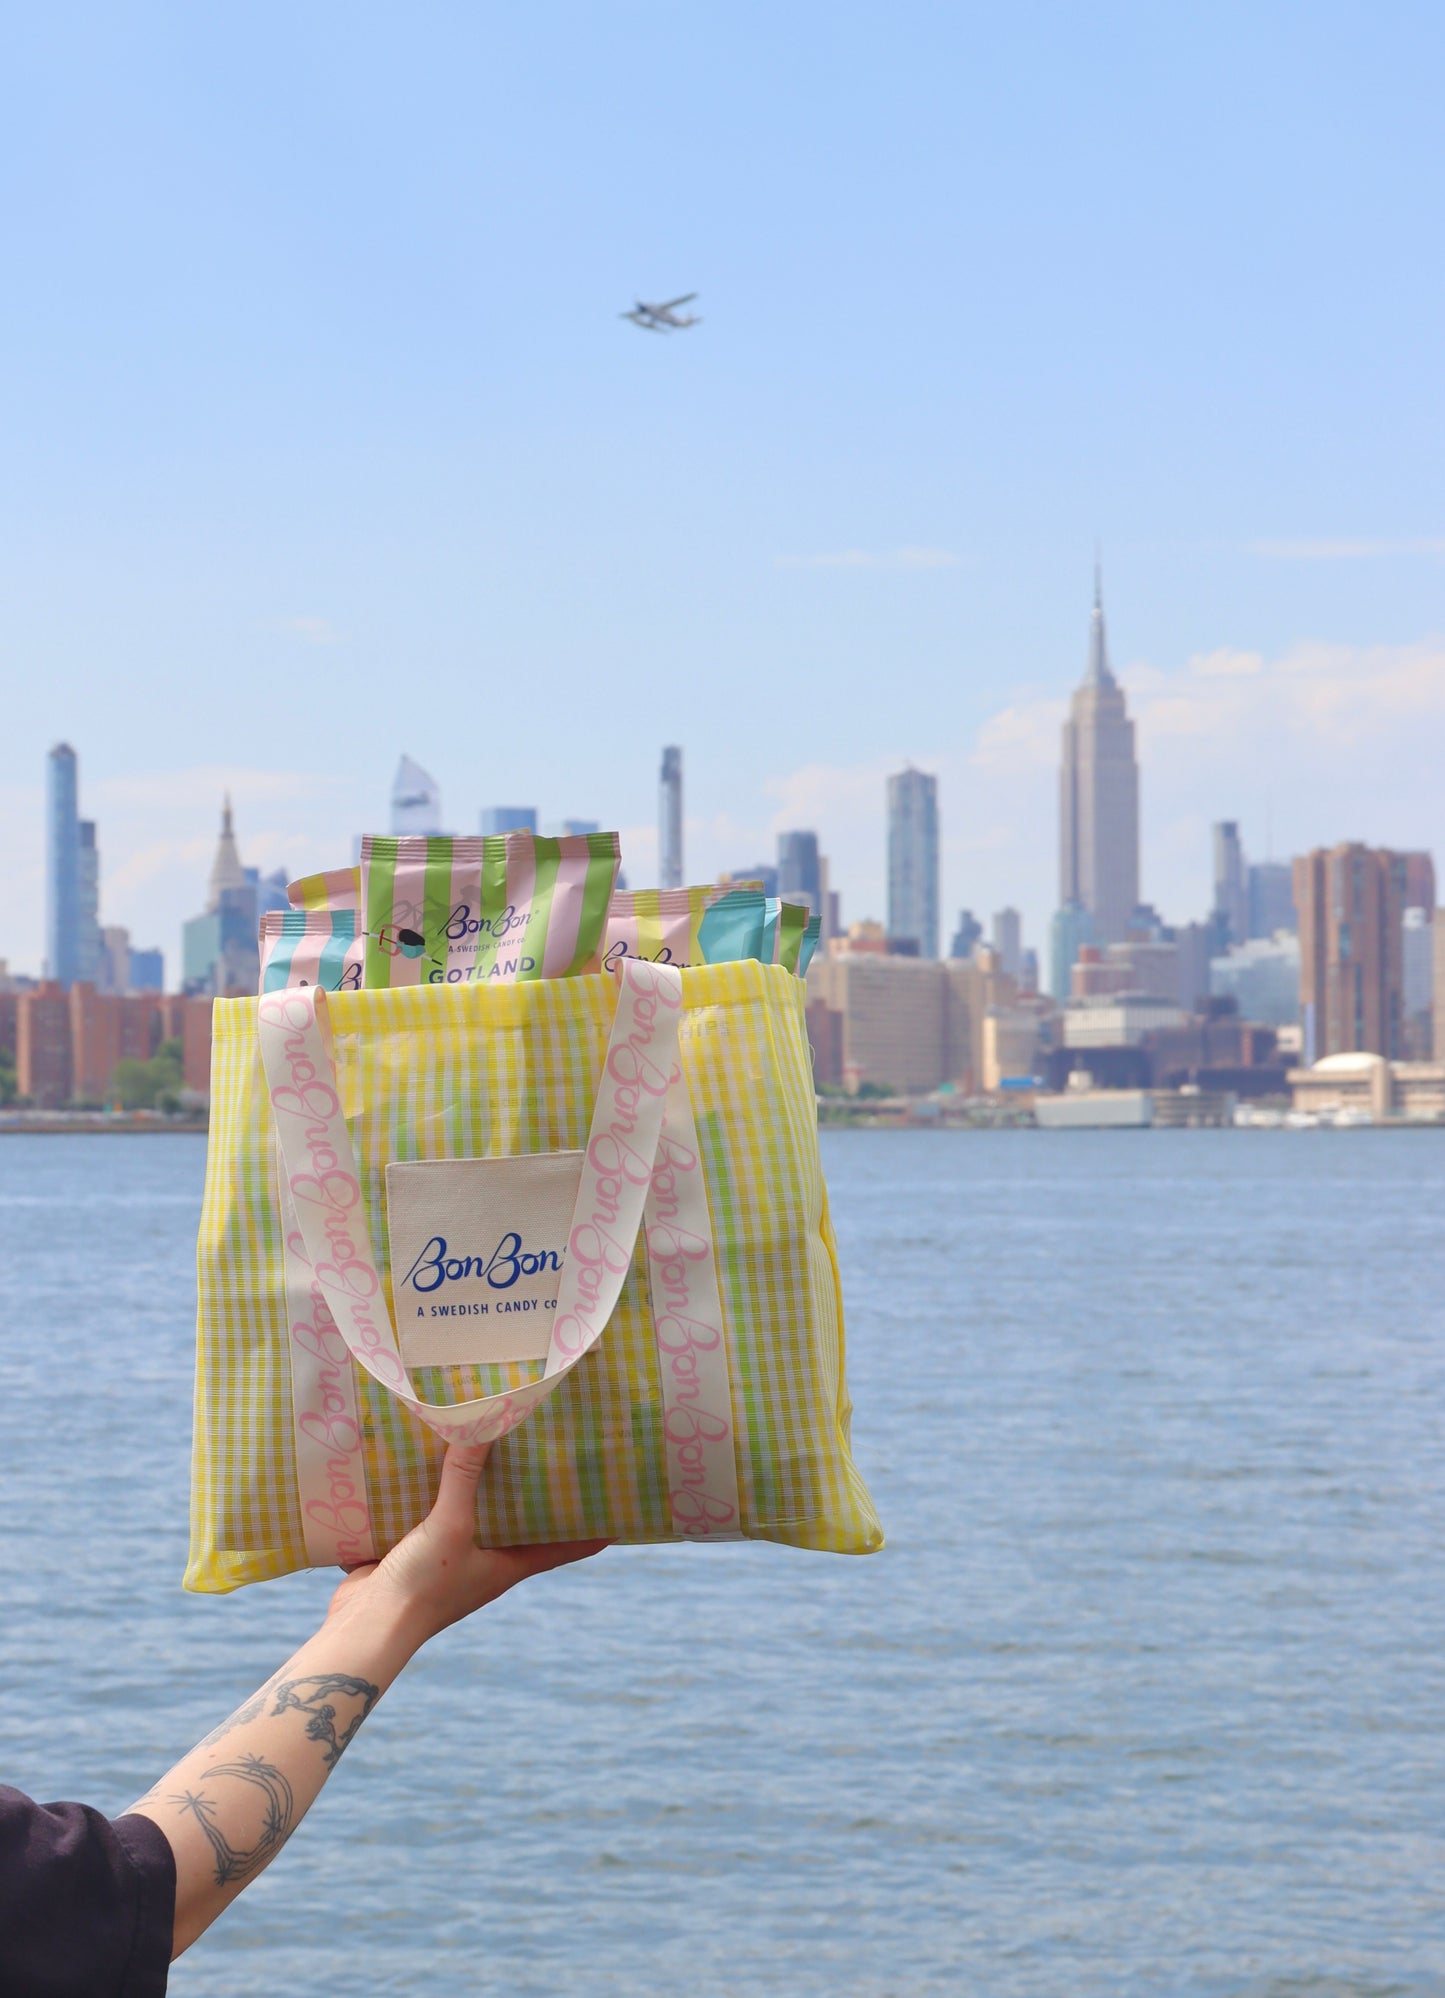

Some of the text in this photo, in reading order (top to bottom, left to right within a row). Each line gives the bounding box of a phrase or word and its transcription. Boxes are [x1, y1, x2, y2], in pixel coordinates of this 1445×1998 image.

[437, 905, 533, 939] BonBon
[448, 945, 454, 953] A
[457, 943, 491, 953] SWEDISH
[493, 940, 515, 949] CANDY
[429, 957, 535, 984] GOTLAND
[400, 1232, 564, 1292] BonBon
[417, 1306, 425, 1317] A
[431, 1304, 489, 1317] SWEDISH
[496, 1300, 538, 1313] CANDY
